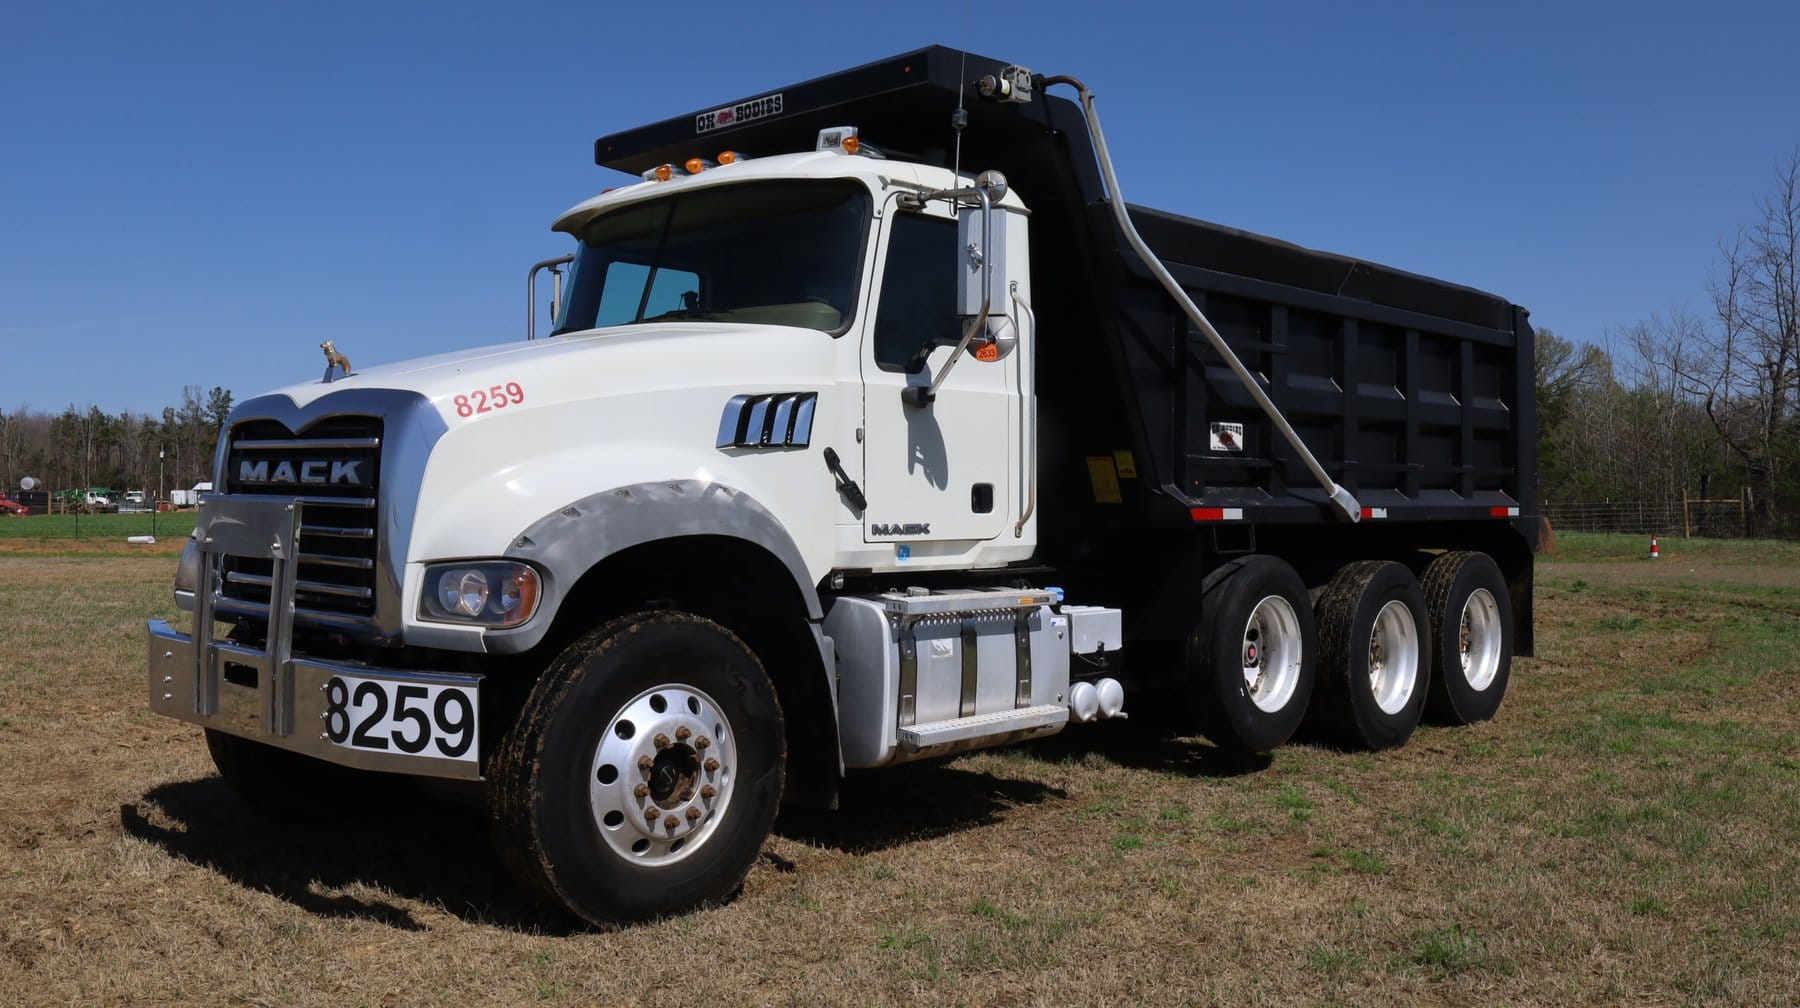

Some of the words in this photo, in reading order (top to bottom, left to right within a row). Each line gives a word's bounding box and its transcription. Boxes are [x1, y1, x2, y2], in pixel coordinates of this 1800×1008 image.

[735, 96, 781, 122] BODIES
[453, 382, 524, 417] 8259
[239, 460, 363, 484] MACK
[871, 523, 931, 536] MACK
[325, 676, 475, 758] 8259
